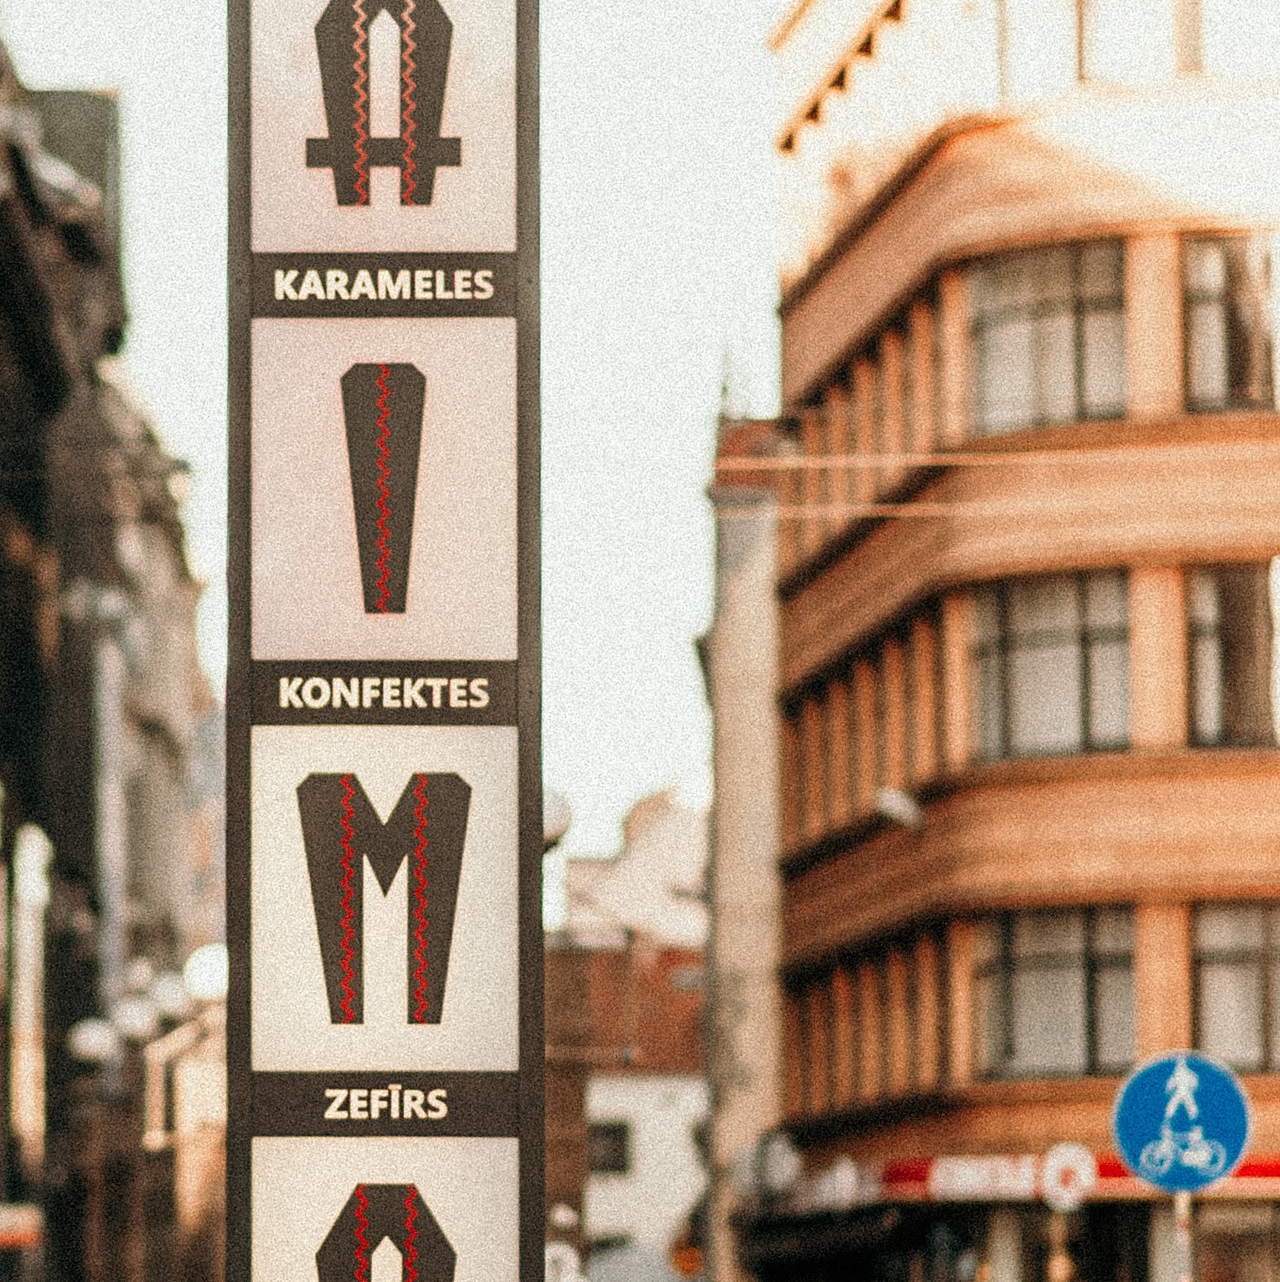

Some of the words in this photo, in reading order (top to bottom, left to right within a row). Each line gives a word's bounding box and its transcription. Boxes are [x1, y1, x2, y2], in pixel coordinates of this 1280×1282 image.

[274, 269, 494, 300] KARAMELES
[279, 676, 490, 709] KONFEKTES
[324, 1084, 448, 1120] ZEFĪRS
